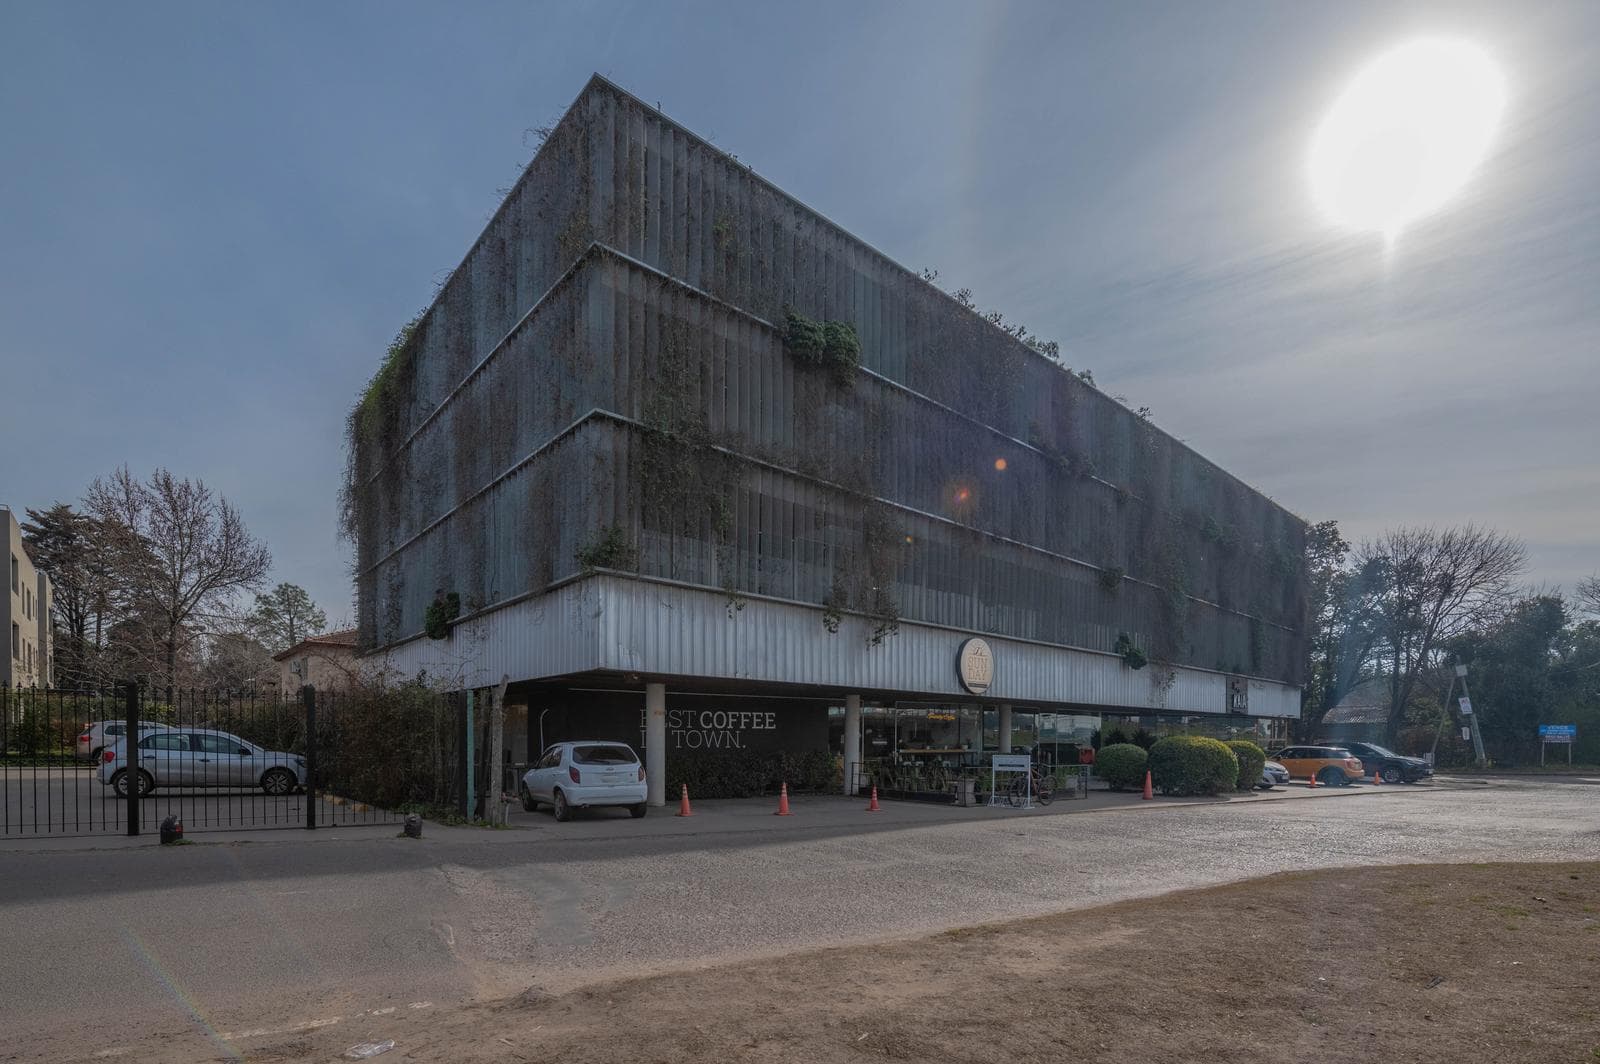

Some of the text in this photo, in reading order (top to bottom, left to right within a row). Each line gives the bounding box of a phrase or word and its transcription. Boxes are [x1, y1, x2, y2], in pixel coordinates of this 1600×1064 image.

[968, 656, 988, 669] SUN
[968, 668, 986, 680] DAY
[640, 709, 776, 729] ST COFFEE
[672, 730, 746, 749] TOWN.
